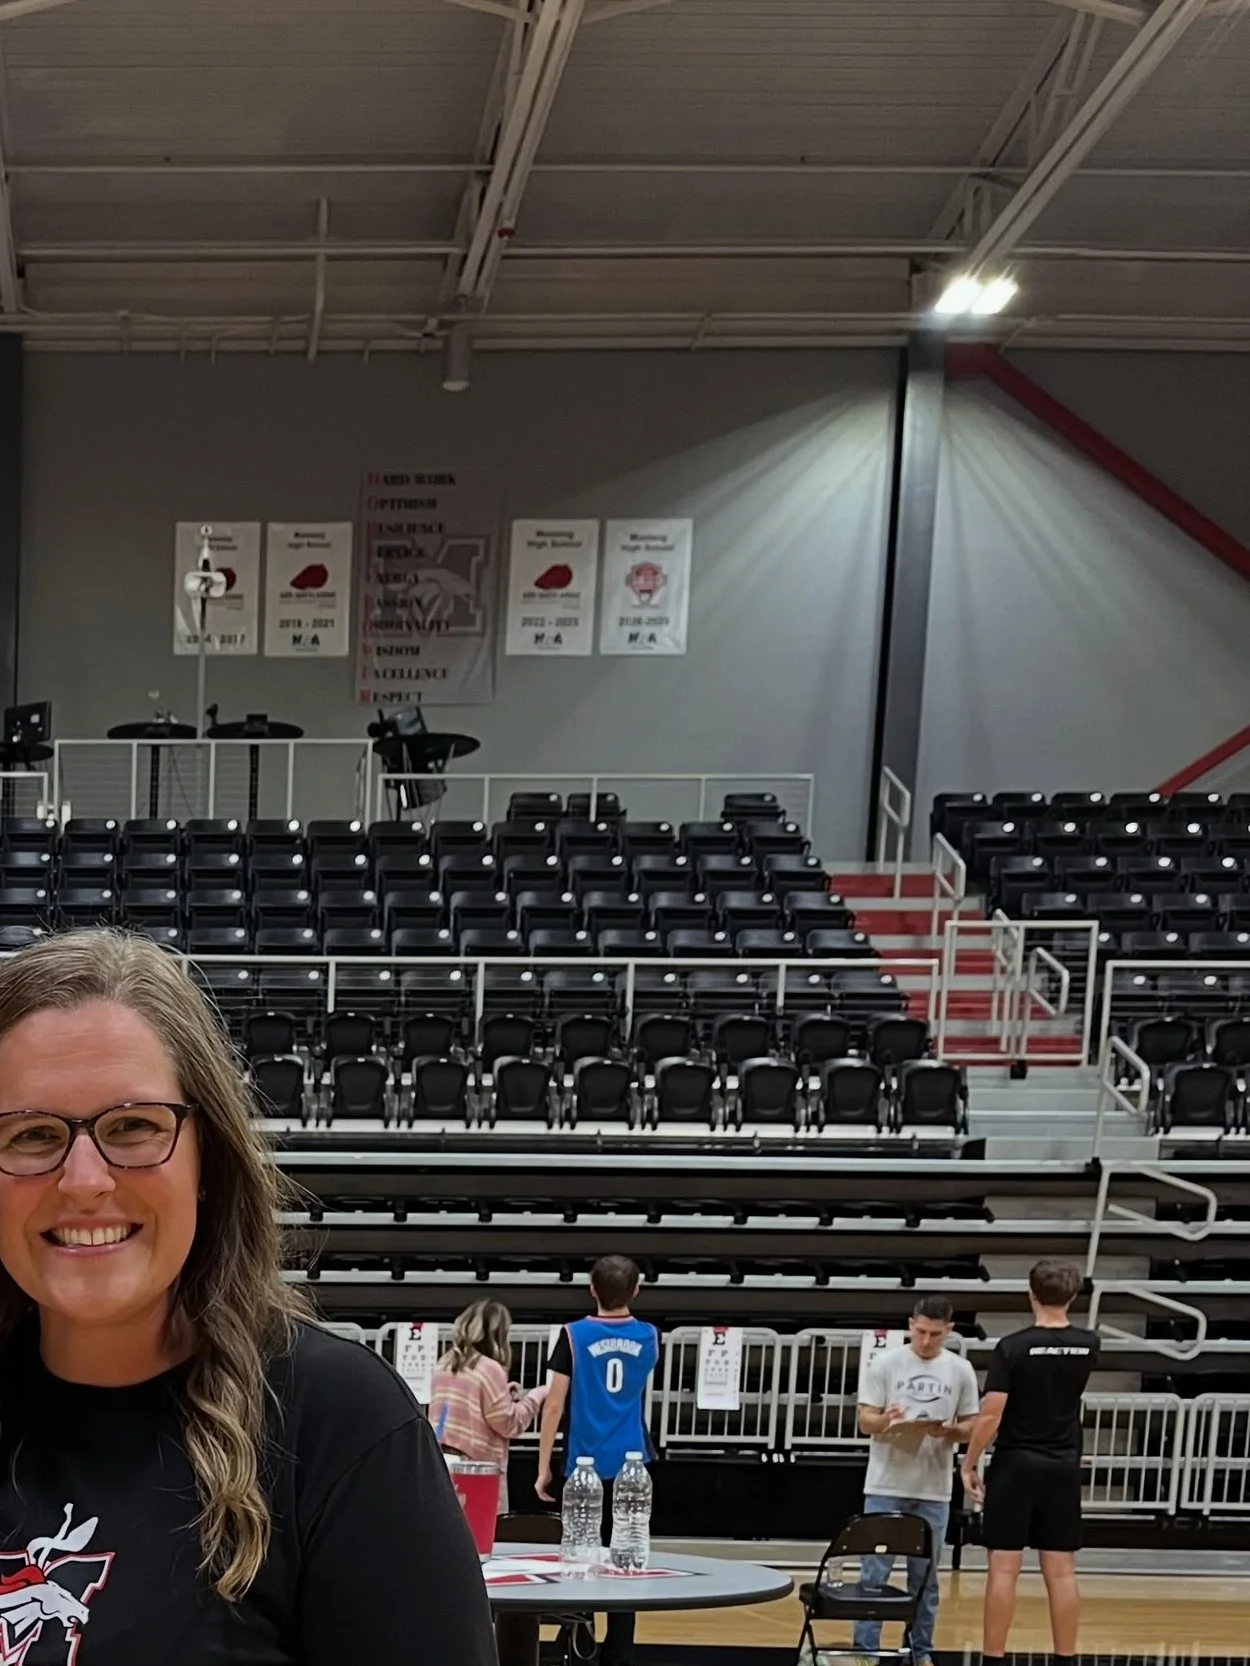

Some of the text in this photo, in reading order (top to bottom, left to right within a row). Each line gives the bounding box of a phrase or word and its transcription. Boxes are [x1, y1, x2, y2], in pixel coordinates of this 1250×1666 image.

[712, 1331, 726, 1345] E
[606, 1357, 623, 1393] 0
[896, 1380, 952, 1395] PARTIN
